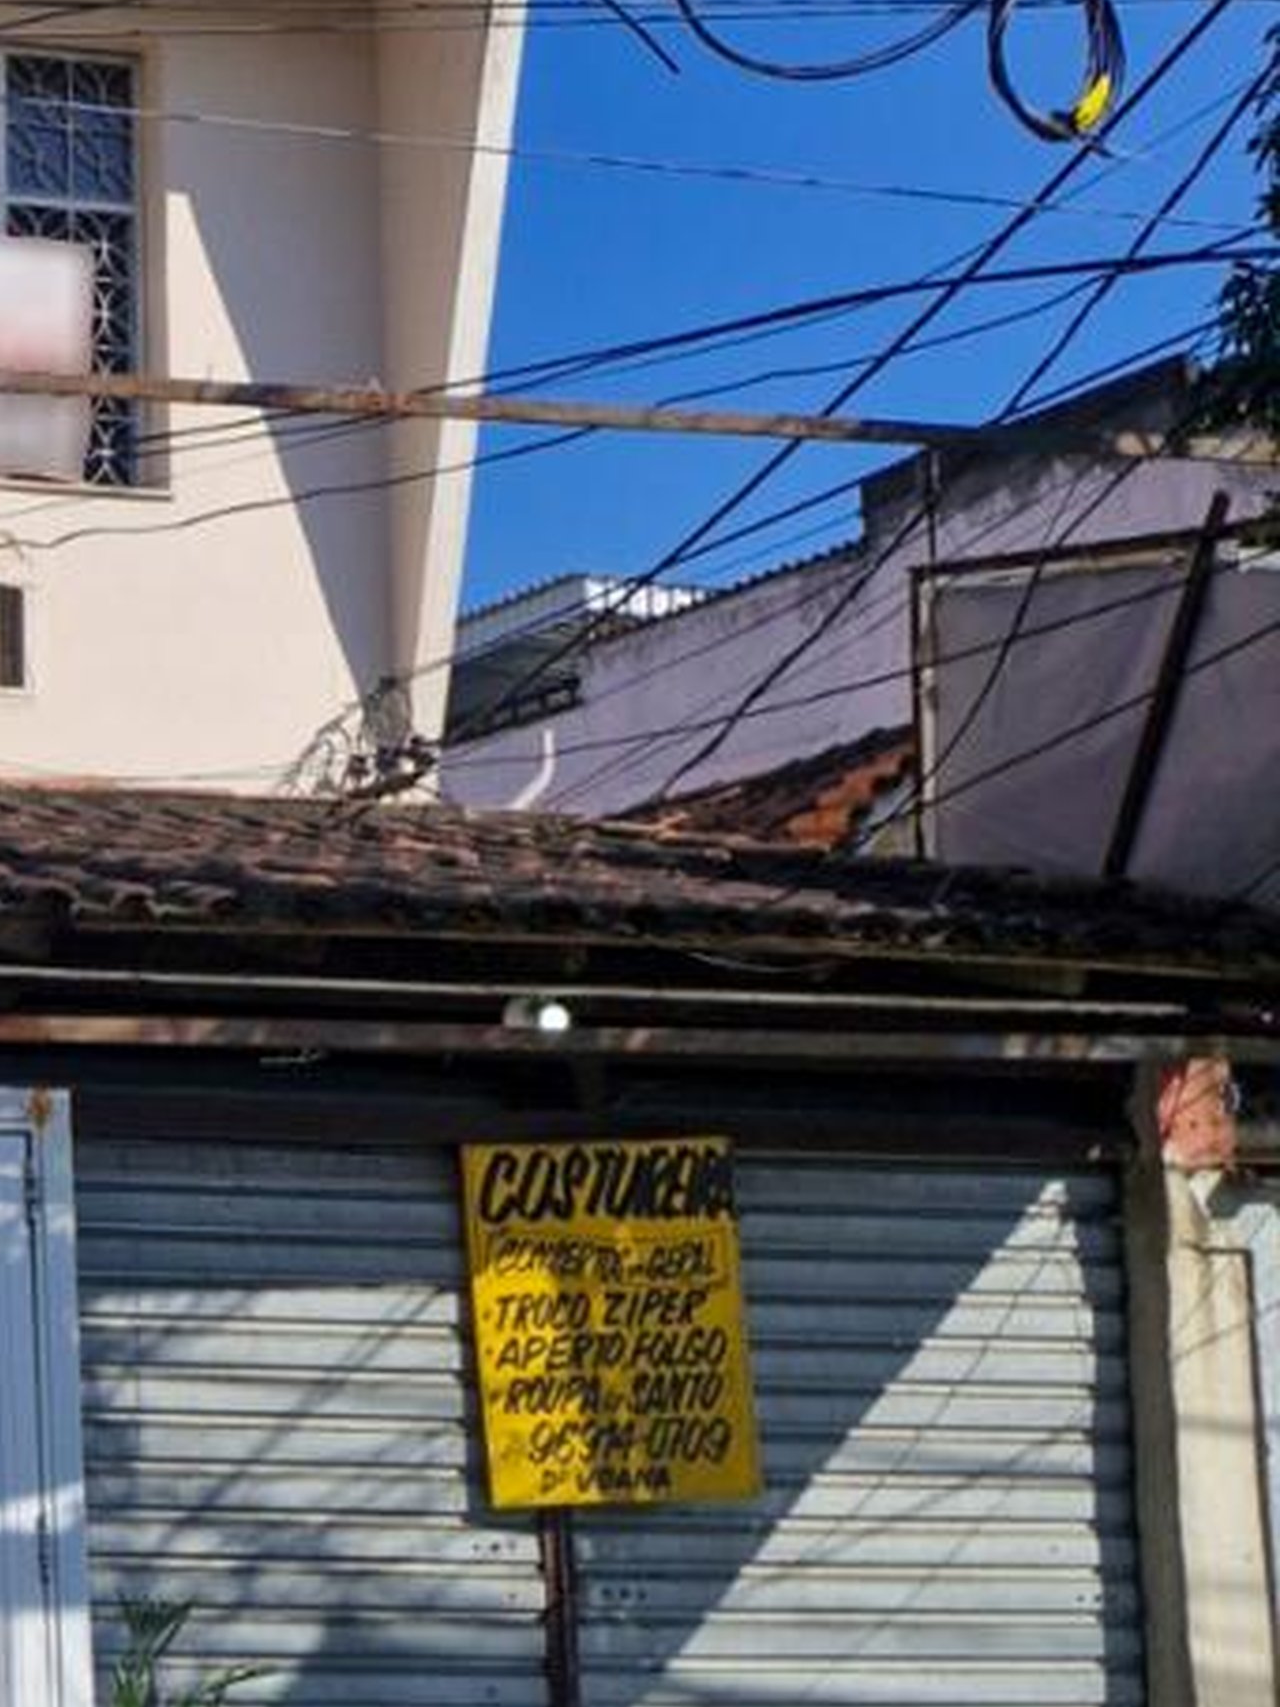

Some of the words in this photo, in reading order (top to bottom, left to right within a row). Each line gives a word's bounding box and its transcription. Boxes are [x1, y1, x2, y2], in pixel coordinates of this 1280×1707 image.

[481, 1147, 737, 1222] COSTUREIRA
[495, 1295, 592, 1332] TROCO
[603, 1290, 708, 1327] ZIPER
[495, 1334, 627, 1372] APERTO
[630, 1328, 728, 1370] FOLGO
[503, 1375, 602, 1415] ROUPA
[630, 1370, 724, 1415] SANTO
